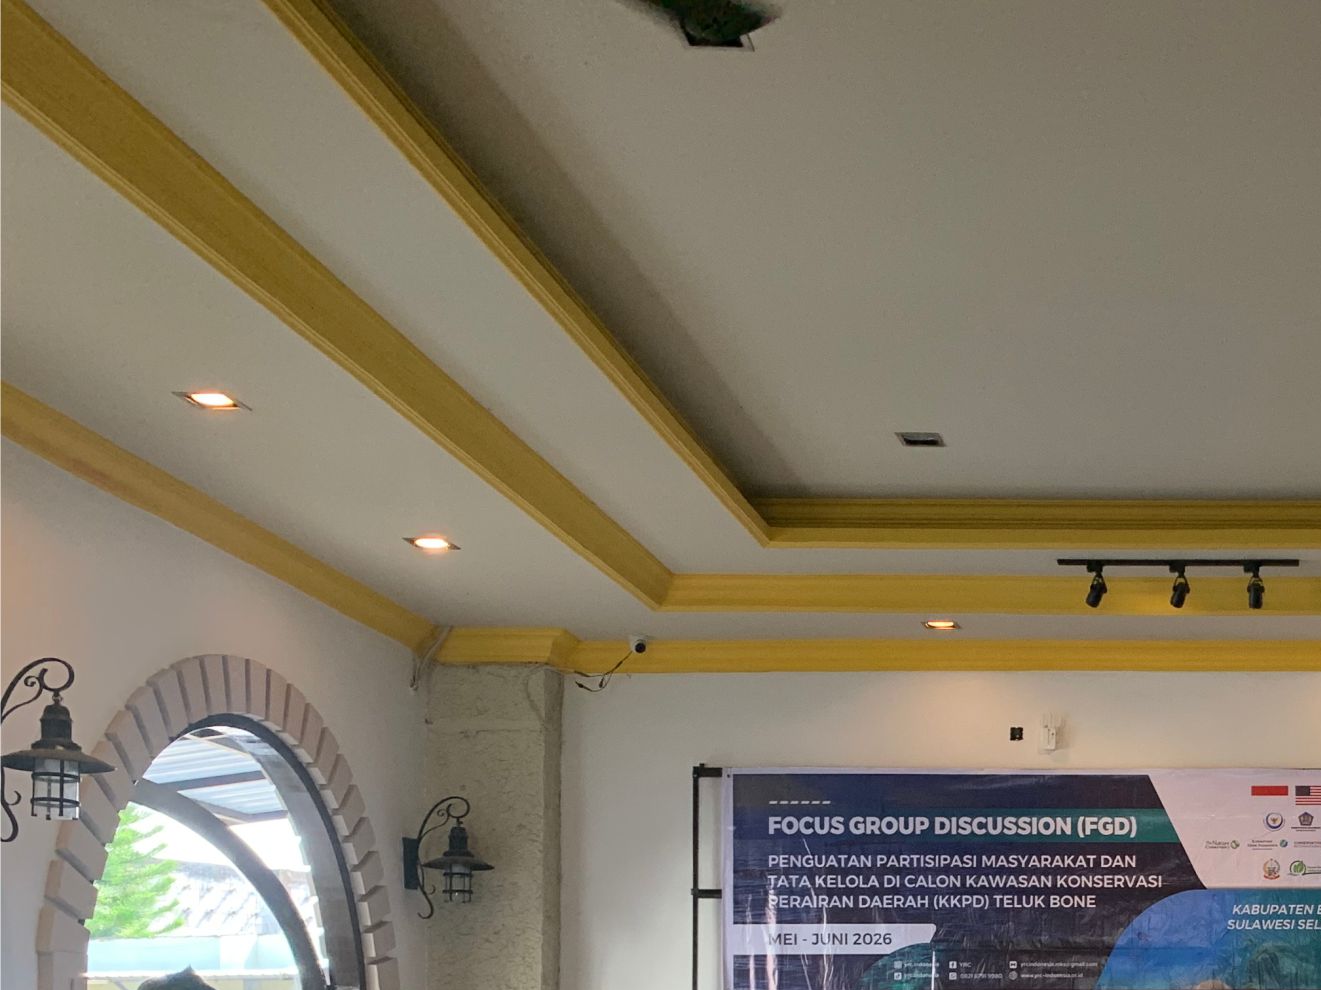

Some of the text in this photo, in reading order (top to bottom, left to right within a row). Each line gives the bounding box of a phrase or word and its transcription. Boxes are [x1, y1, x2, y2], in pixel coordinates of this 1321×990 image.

[768, 816, 1138, 838] FOCUS GROUP DISCUSSION (FGD)
[768, 854, 1137, 868] PENGUATAN PARTISIPASI MASYARAKAT DAN
[767, 874, 1162, 888] TATA KELOLA DI CALON KAWASAN KONSERVASI
[768, 894, 1097, 910] PERAIRAN DAERAH (KKPD) TELUK BONE
[1232, 904, 1314, 915] KABUPATEN
[1227, 919, 1294, 930] SULAWESI
[768, 933, 798, 945] MEI
[811, 933, 848, 945] JUNI
[853, 933, 892, 945] 2026
